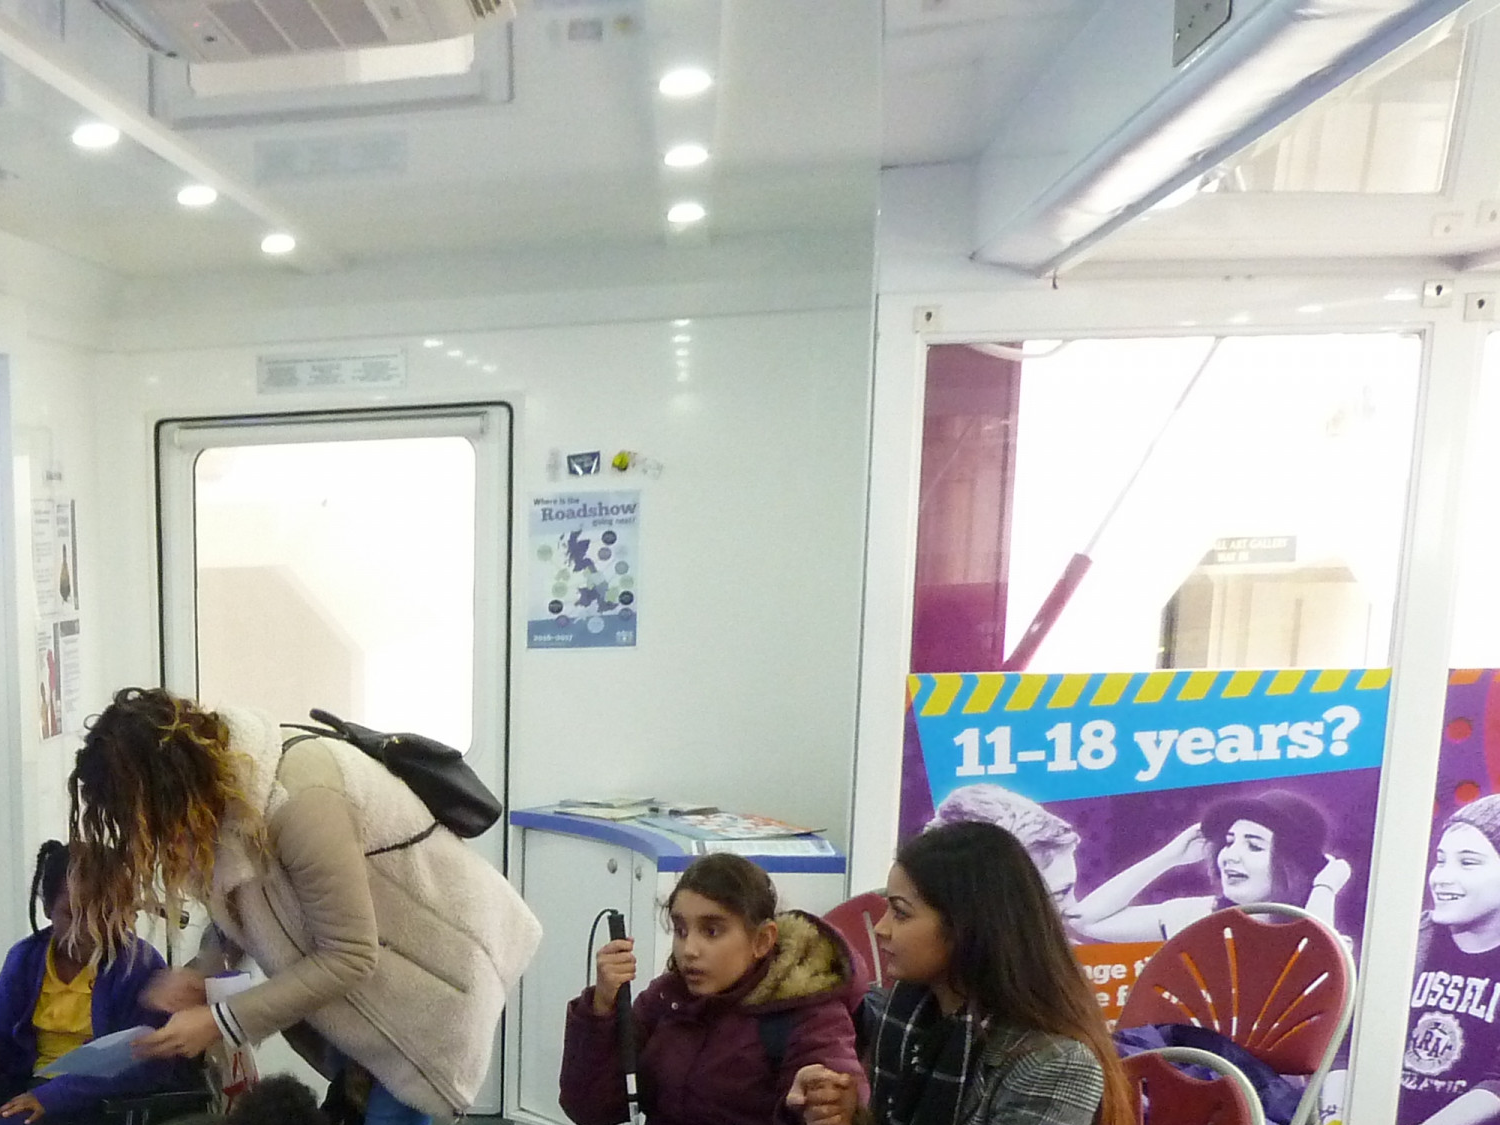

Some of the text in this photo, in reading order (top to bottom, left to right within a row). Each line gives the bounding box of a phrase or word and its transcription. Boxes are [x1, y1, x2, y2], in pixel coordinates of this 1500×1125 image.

[541, 501, 638, 522] Roadshow
[952, 705, 1360, 782] 11-18 years?
